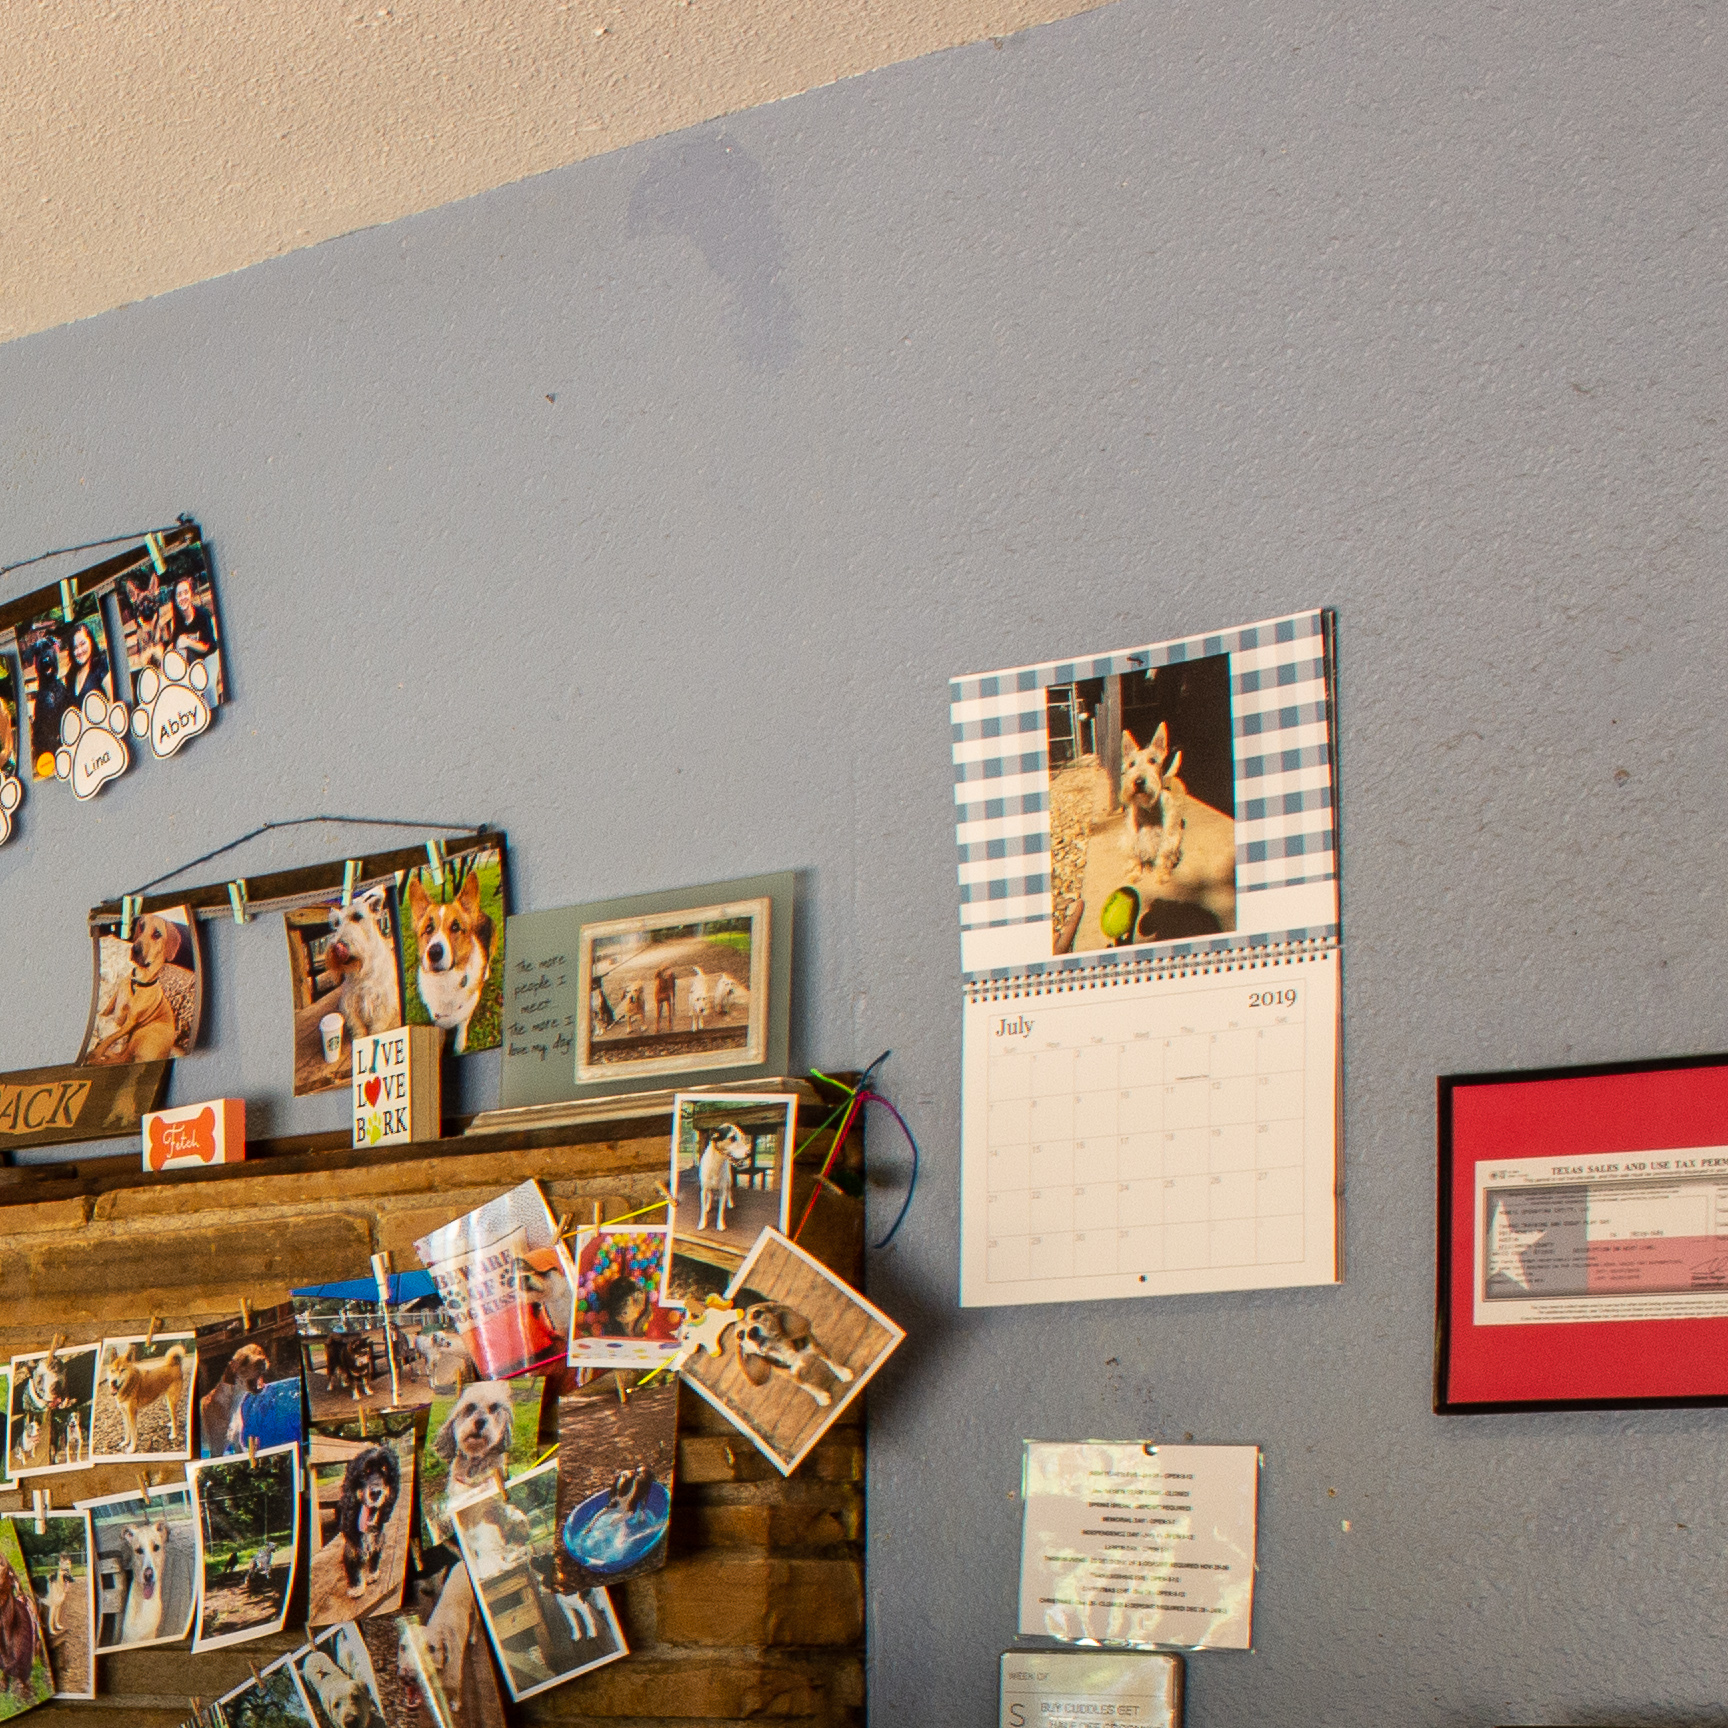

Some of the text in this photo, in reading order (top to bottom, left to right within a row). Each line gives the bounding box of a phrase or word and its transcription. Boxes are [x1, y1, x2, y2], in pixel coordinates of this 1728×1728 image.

[160, 705, 199, 743] Abby
[84, 750, 111, 777] Lina
[539, 954, 566, 968] more
[1248, 989, 1296, 1007] 2019
[531, 1019, 559, 1032] more
[995, 1015, 1035, 1038] July
[163, 1124, 200, 1159] Fetch
[1551, 1165, 1584, 1175] TEXAS
[1587, 1163, 1618, 1173] SALES
[1624, 1162, 1645, 1171] AND
[1651, 1160, 1670, 1170] USE
[1675, 1159, 1695, 1168] TAX
[1010, 1703, 1026, 1728] S
[1041, 1702, 1062, 1713] BUY
[1117, 1705, 1140, 1716] GET
